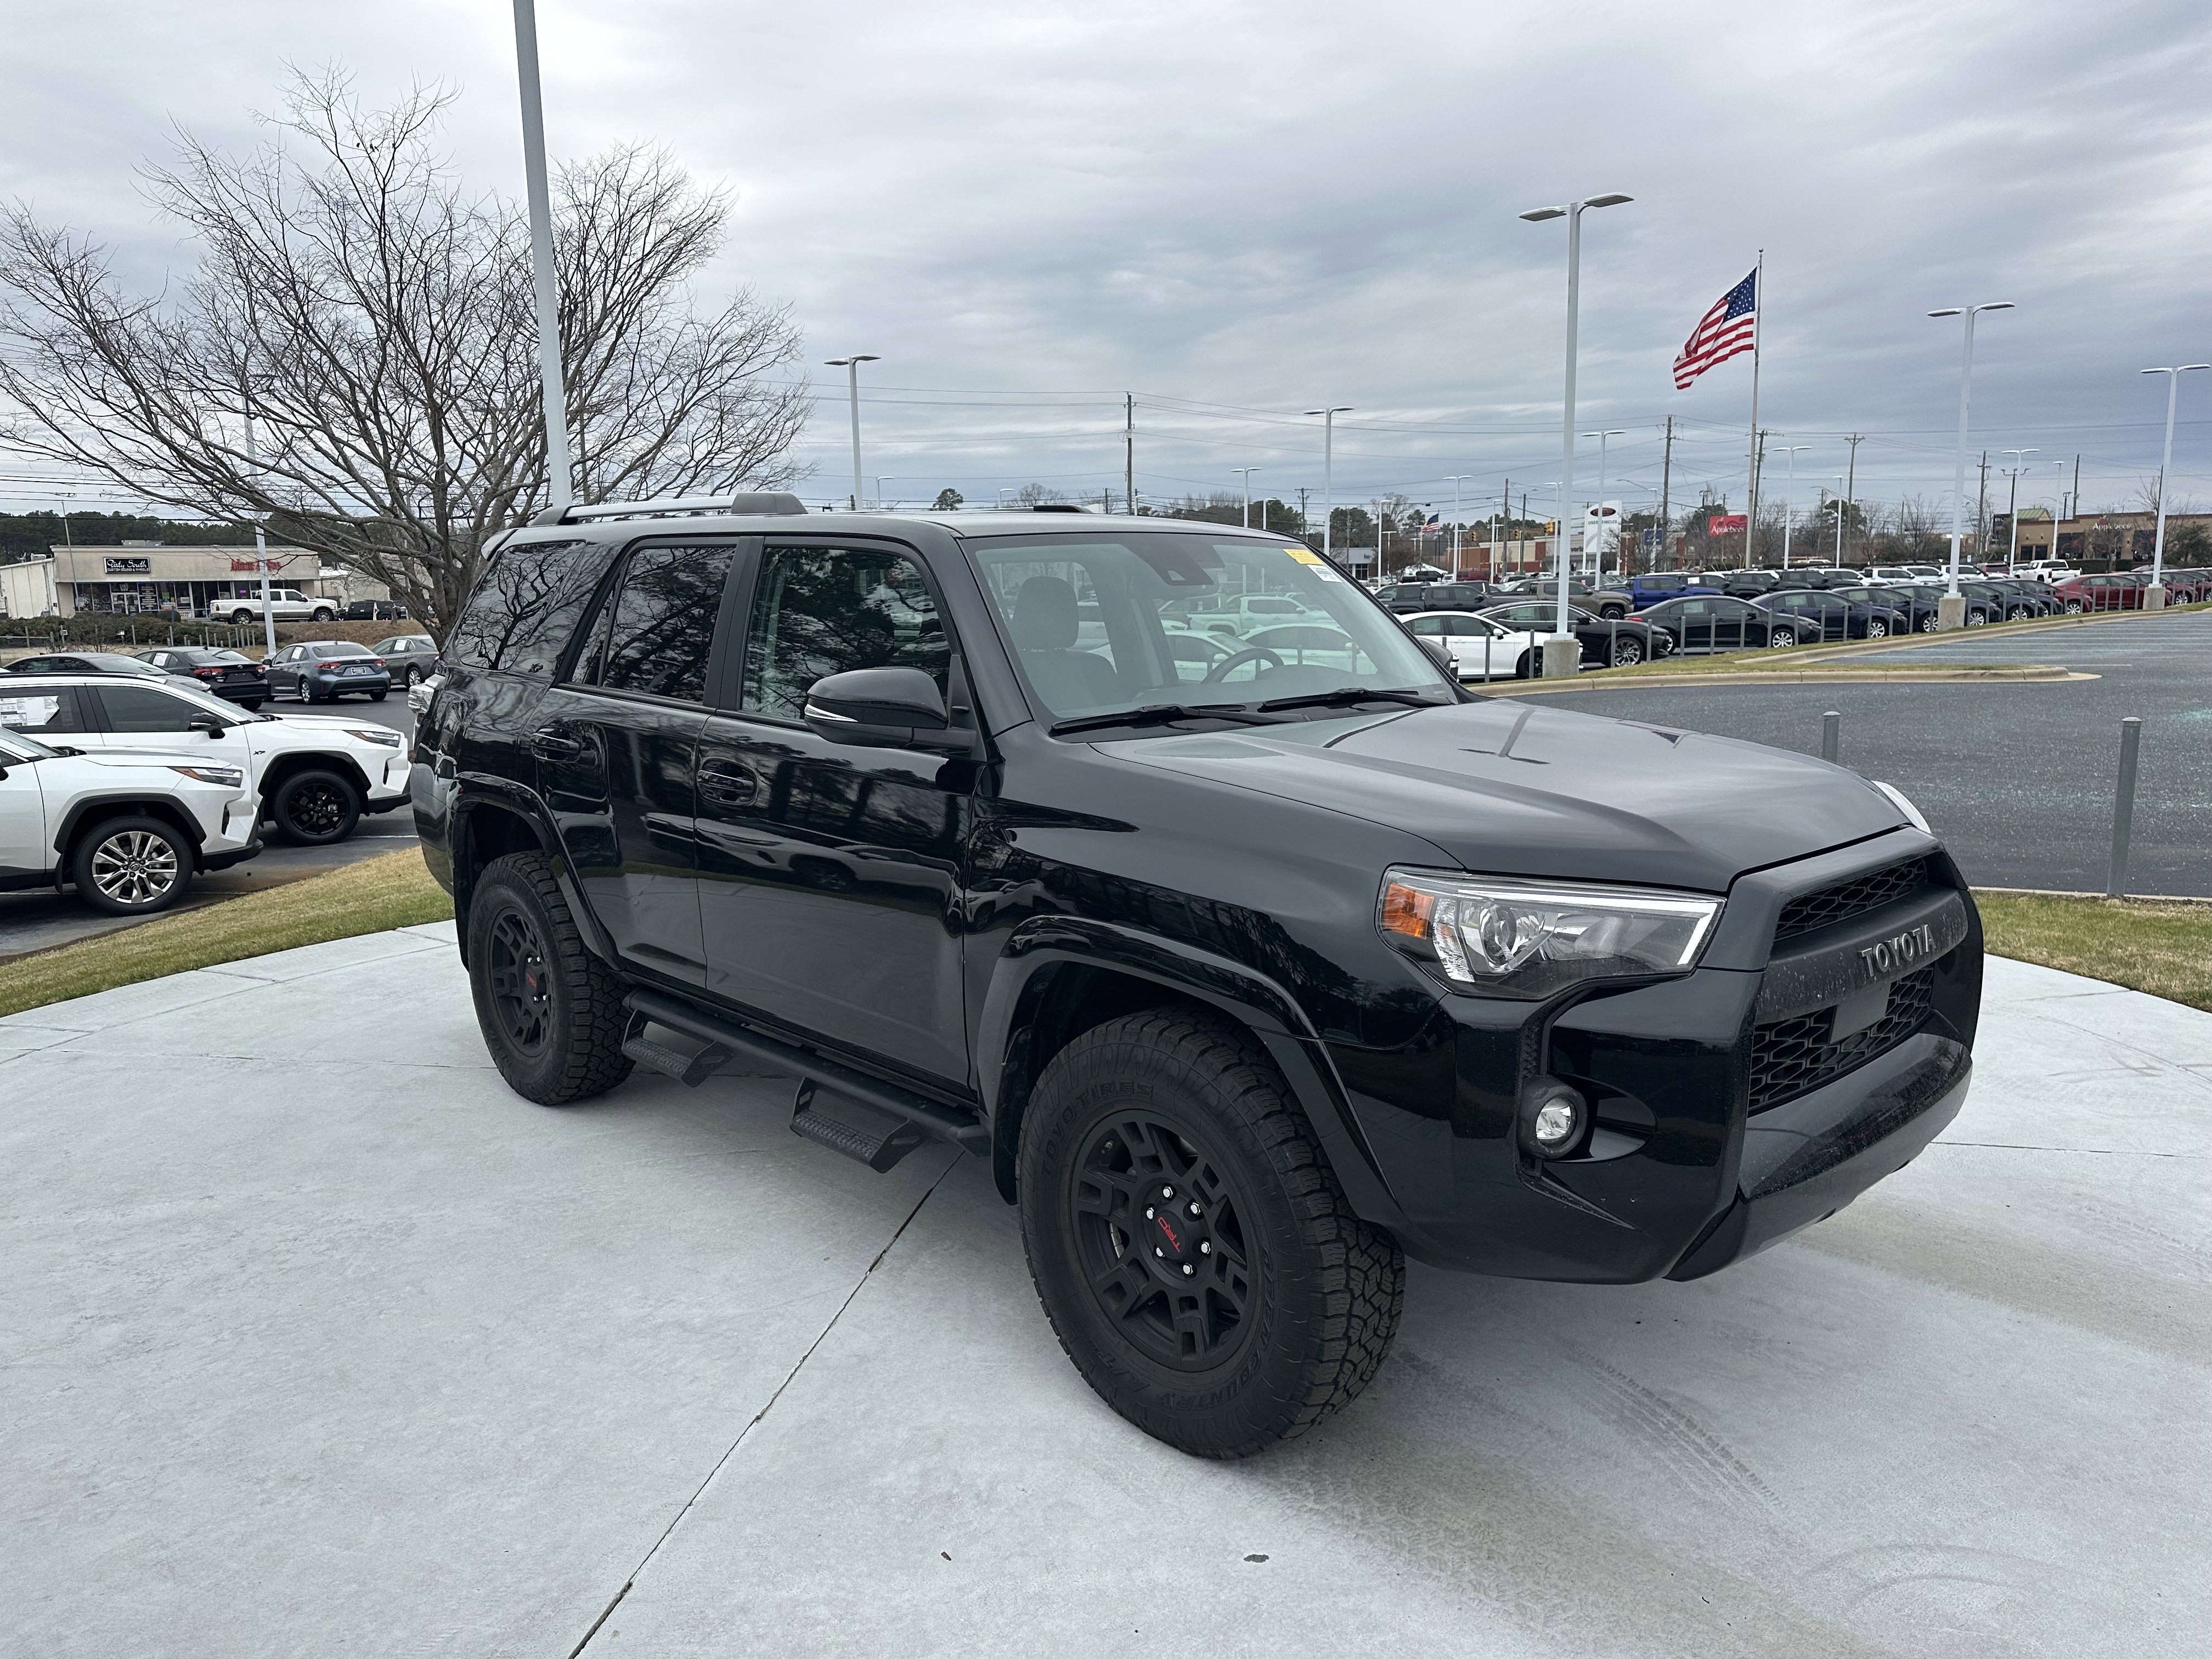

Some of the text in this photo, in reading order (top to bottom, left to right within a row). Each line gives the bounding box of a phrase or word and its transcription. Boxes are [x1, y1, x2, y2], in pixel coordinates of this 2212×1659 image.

[107, 559, 147, 568] Dirty South
[1858, 923, 1937, 978] TOYOTA
[1041, 1079, 1154, 1179] TOYO TIRES
[1158, 1216, 1181, 1253] TRD
[1159, 1347, 1261, 1412] COUNTRY
